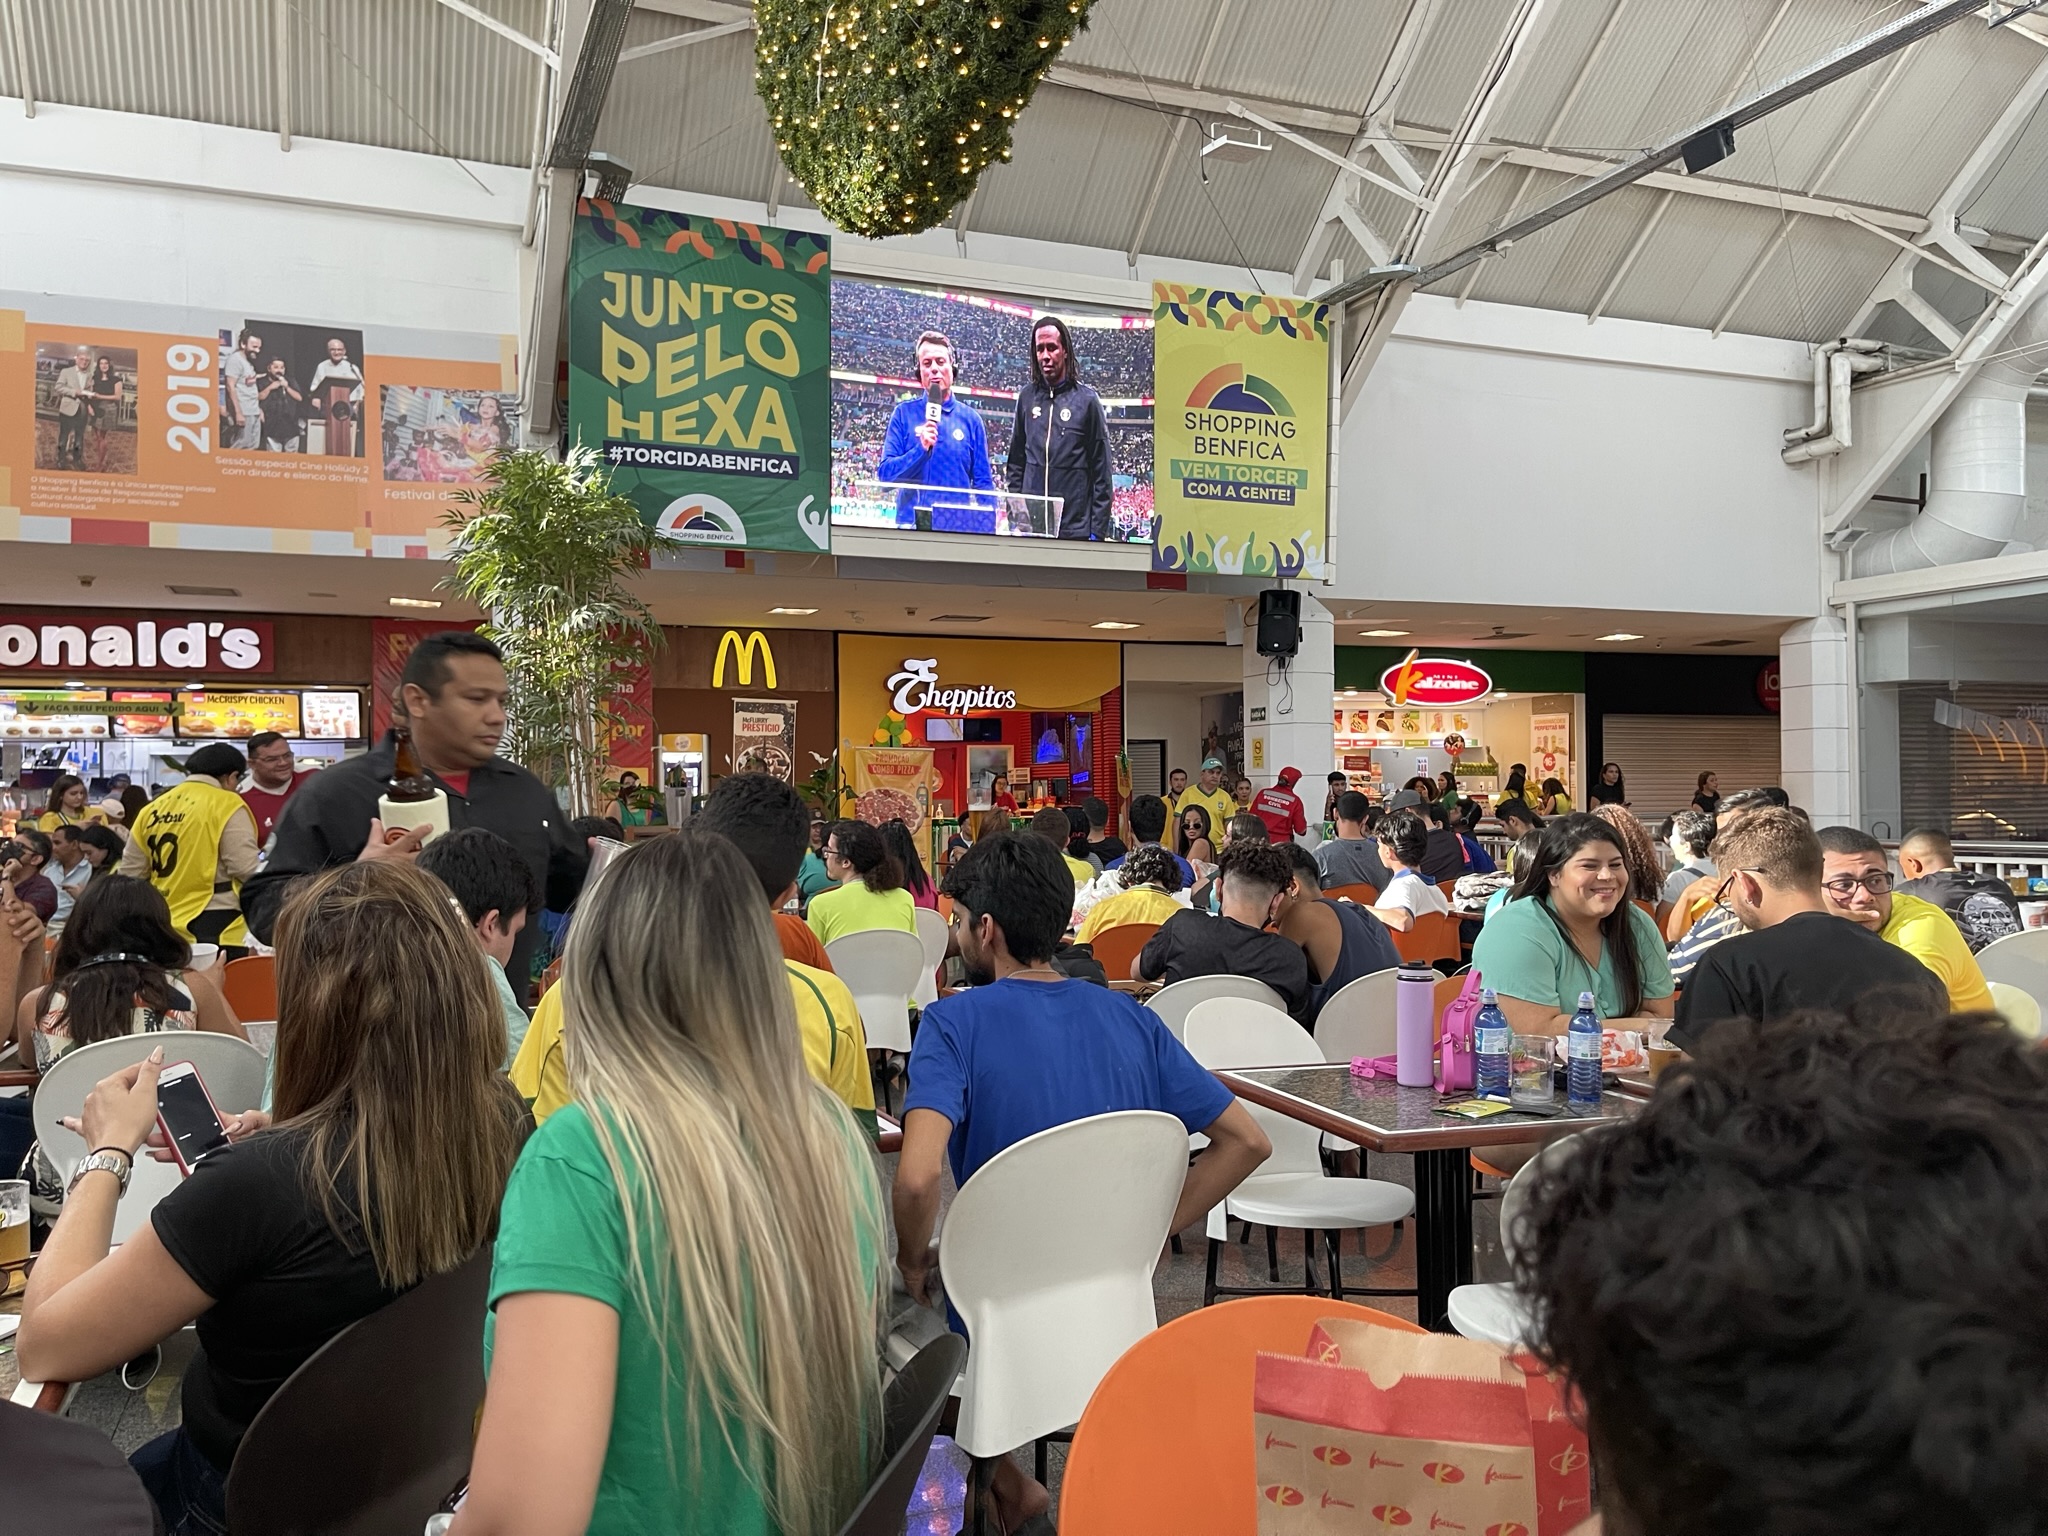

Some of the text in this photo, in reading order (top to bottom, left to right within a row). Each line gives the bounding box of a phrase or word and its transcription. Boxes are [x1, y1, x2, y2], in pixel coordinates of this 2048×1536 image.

[601, 271, 798, 328] JUNTOS
[602, 319, 800, 399] PELO
[166, 344, 210, 454] 2019
[607, 385, 797, 453] HEXA
[1184, 412, 1296, 439] SHOPPING
[1194, 436, 1286, 461] BENFICA
[215, 456, 370, 475] Sessão especial Cine Holiúdy 2
[609, 446, 793, 475] #TORCIDABENFICA
[222, 467, 368, 484] com diretor e elenco do filme
[1179, 461, 1299, 486] VEM TORCER
[384, 488, 435, 501] Festival
[1187, 482, 1291, 502] COM A GENTE!
[669, 531, 735, 542] SHOPPING BENFICA
[0, 621, 261, 669] onald's
[1395, 648, 1480, 704] Kalzone
[44, 704, 70, 713] FAÇA
[73, 704, 93, 712] SEU
[96, 705, 132, 713] PEDIDO
[207, 695, 285, 705] McCRISPY CHICKEN
[742, 716, 769, 724] McFLURRY
[742, 723, 781, 733] PRESTIGIO
[871, 765, 916, 775] COMBO PIZZA
[1263, 795, 1290, 806] BOMBEIRO
[1268, 801, 1282, 809] CIVIL
[147, 832, 179, 878] 10
